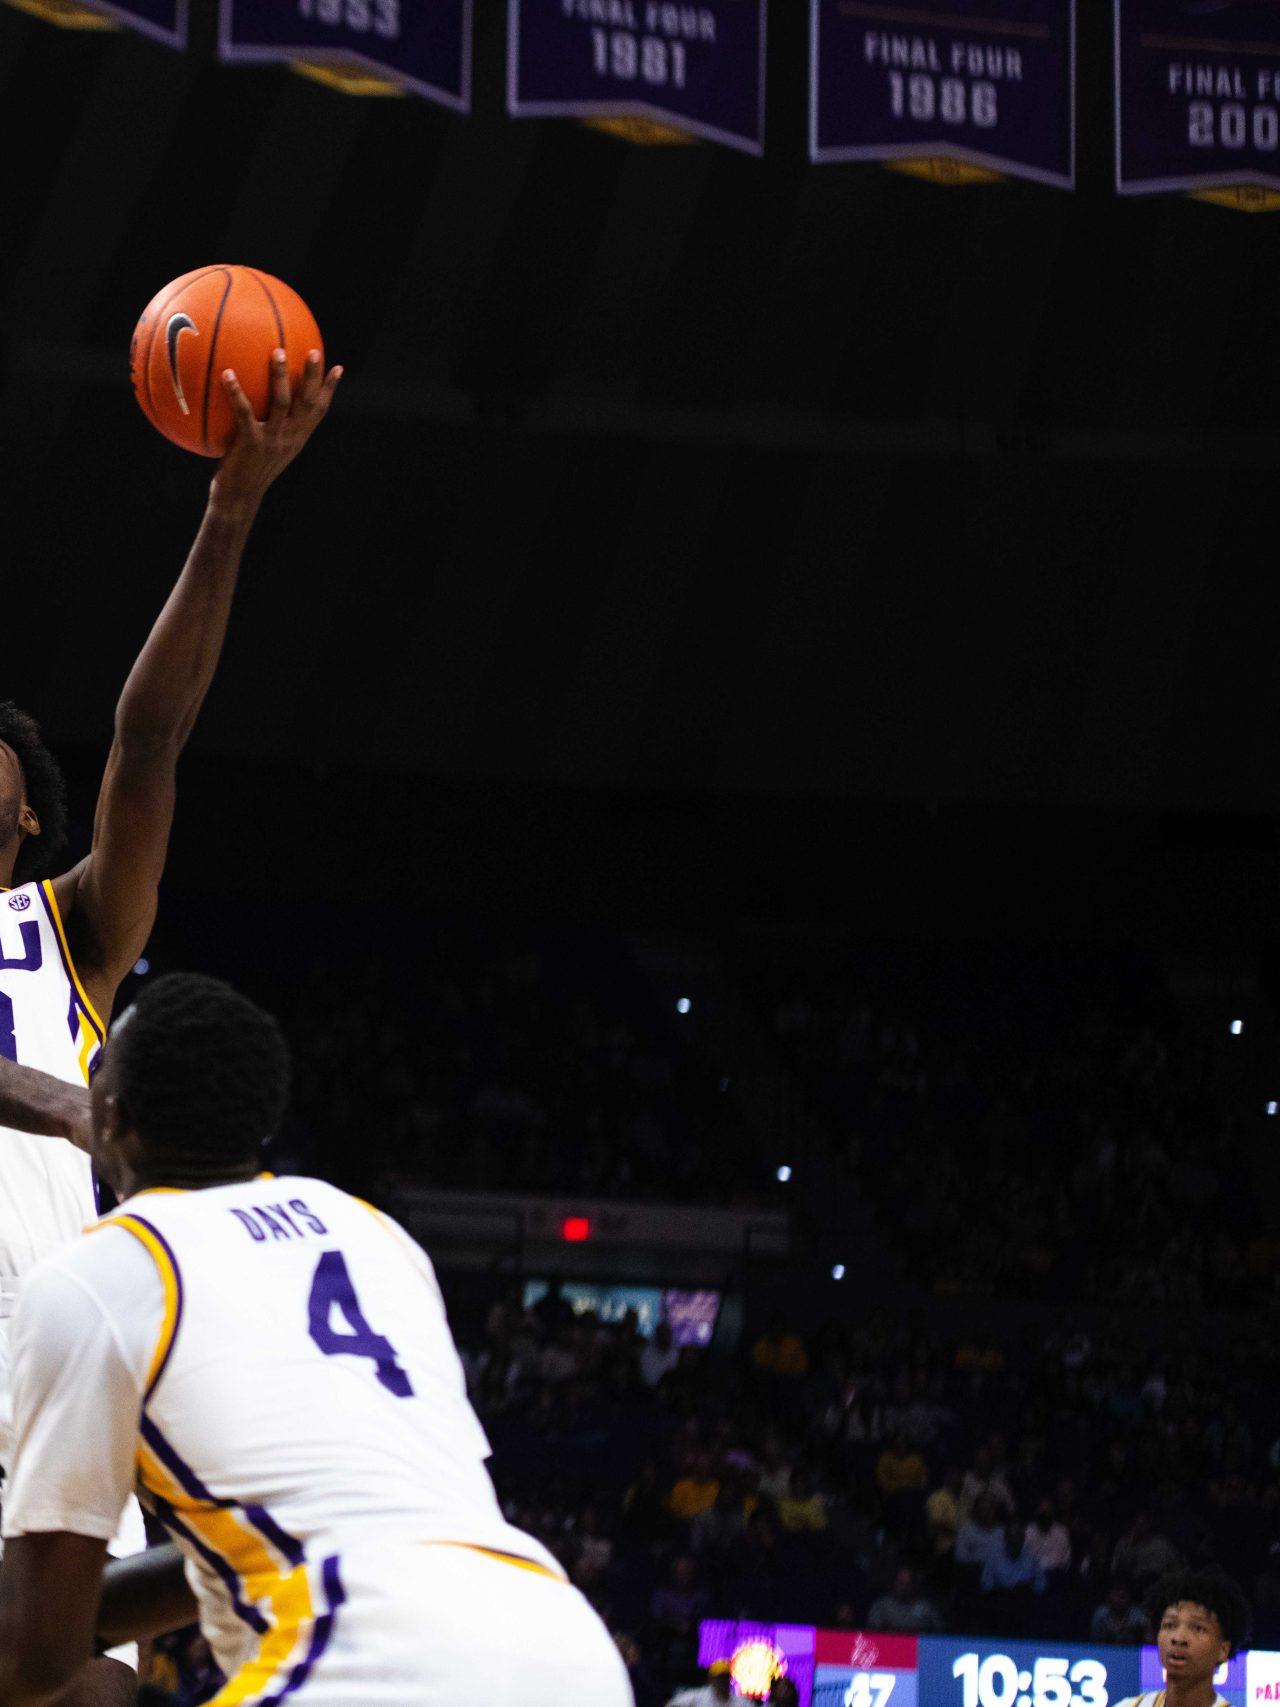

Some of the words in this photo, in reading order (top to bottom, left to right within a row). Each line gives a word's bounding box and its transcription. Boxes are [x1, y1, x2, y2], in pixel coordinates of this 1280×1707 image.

[645, 2, 716, 42] FOUR
[591, 27, 684, 88] 1981
[864, 31, 941, 71] FINAL
[951, 41, 1023, 80] FOUR
[1169, 64, 1246, 98] FINAL
[888, 69, 997, 127] 1986
[228, 1198, 328, 1243] DAYS
[307, 1250, 415, 1398] 4
[952, 1652, 1109, 1707] 10:53
